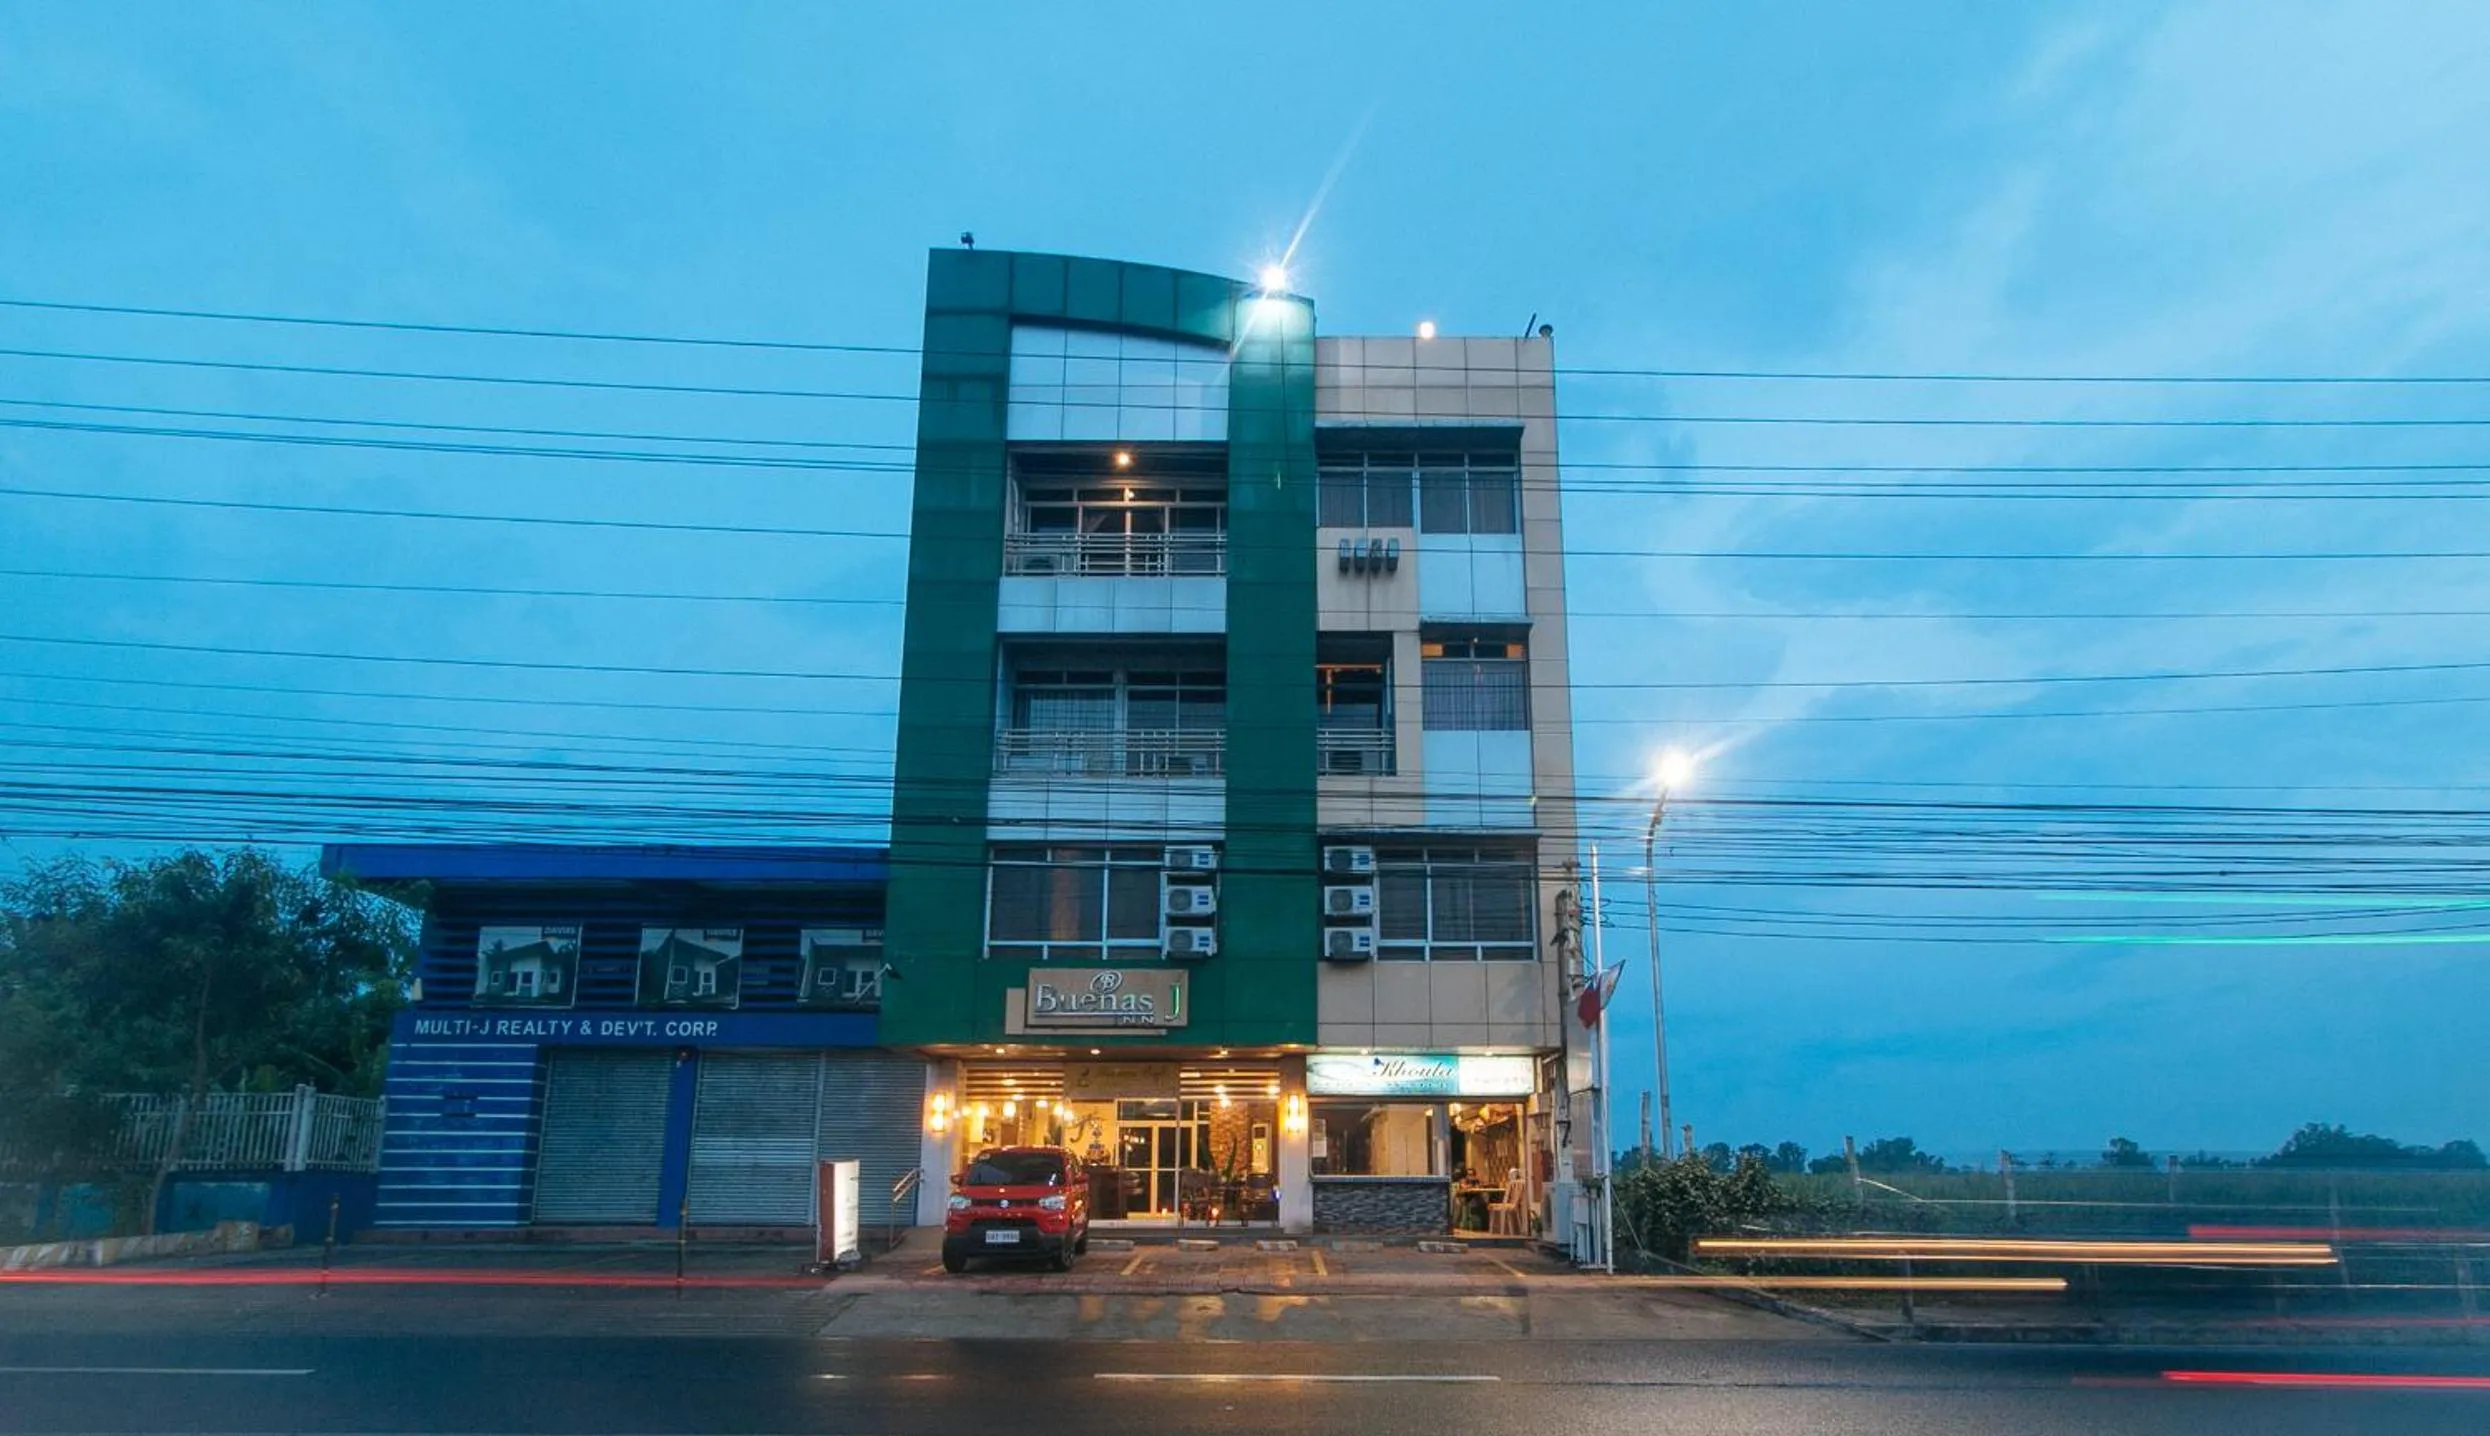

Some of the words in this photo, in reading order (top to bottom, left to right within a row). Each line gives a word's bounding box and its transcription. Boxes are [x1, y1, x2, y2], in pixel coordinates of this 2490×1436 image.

[1037, 983, 1153, 1011] Buenas
[1164, 982, 1181, 1021] J
[414, 1020, 490, 1035] MULTI-J
[496, 1020, 573, 1035] REALTY
[580, 1020, 592, 1035] &
[601, 1021, 657, 1036] DEV'T.
